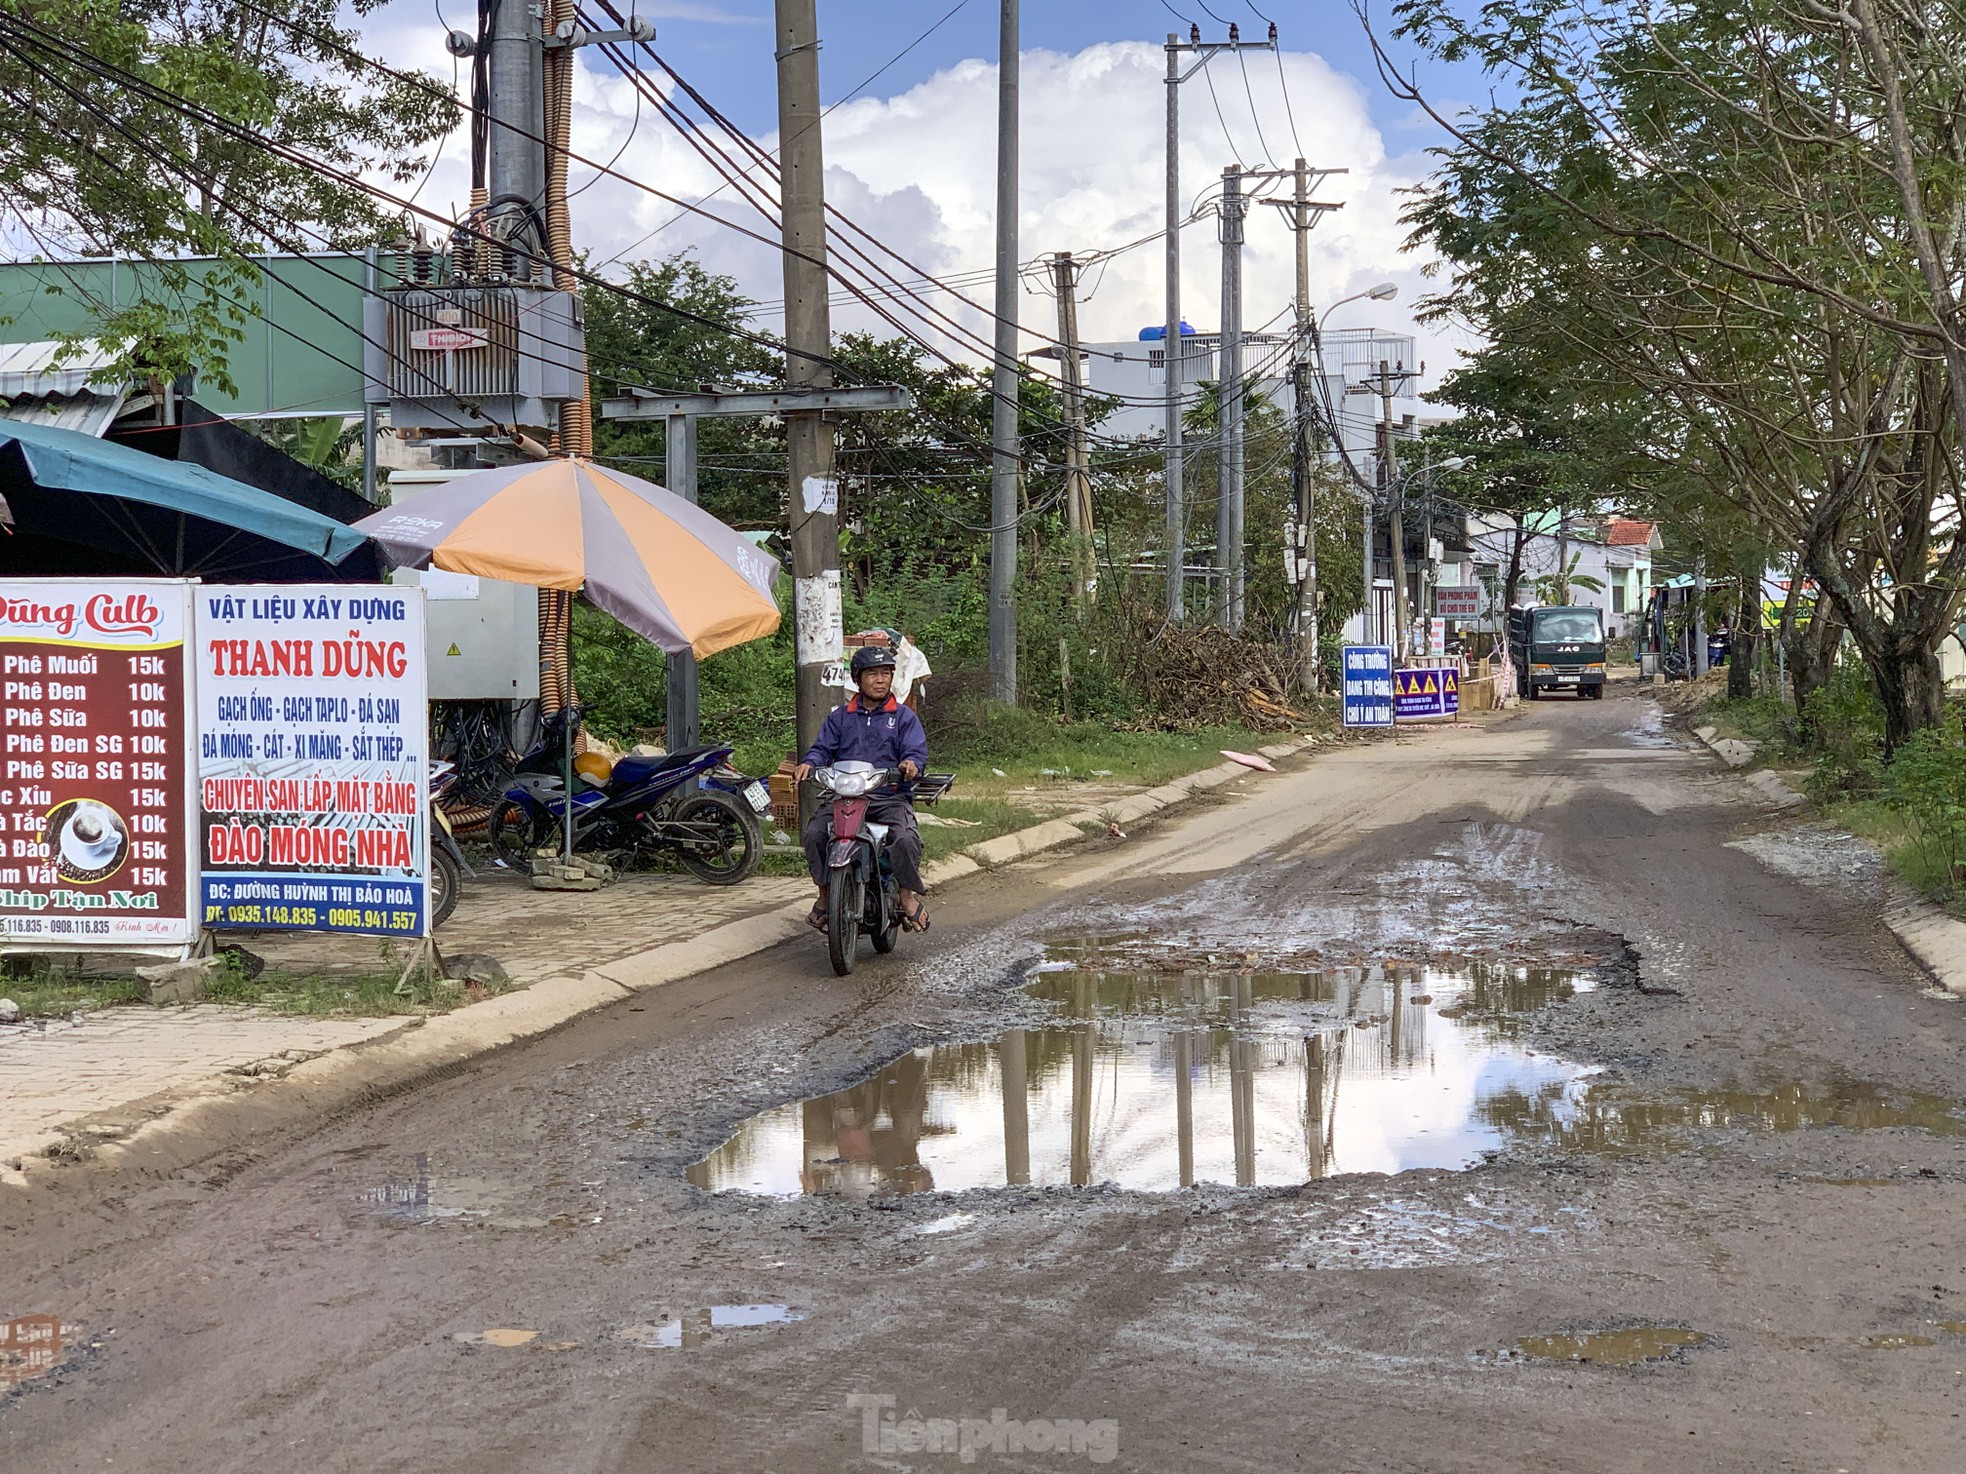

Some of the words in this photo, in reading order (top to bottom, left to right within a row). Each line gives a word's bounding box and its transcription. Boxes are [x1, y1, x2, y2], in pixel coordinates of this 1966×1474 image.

[85, 594, 158, 637] Culb
[209, 594, 246, 623] VẬT
[252, 594, 296, 624] LIỆU
[302, 594, 342, 619] XÂY
[349, 597, 405, 624] DỰNG
[1468, 604, 1475, 613] EM
[5, 655, 42, 674] Phê
[48, 653, 98, 674] Muối
[128, 656, 165, 675] 15k
[210, 639, 313, 677] THANH
[322, 629, 408, 678] DŨNG
[1348, 650, 1365, 670] CÔNG
[1365, 649, 1387, 669] TRƯỜNG
[5, 682, 43, 700] Phê
[48, 682, 87, 701] Đen
[128, 683, 166, 701] 10k
[1364, 680, 1373, 696] THI
[5, 708, 43, 726] Phê
[49, 708, 87, 727] Sữa
[129, 709, 166, 727] 10k
[218, 696, 247, 727] GẠCH
[250, 687, 272, 722] ỐNG
[283, 696, 312, 727] GẠCH
[315, 697, 348, 723] TAPLO
[359, 692, 374, 724] ĐÁ
[377, 698, 400, 729] SẠN
[1347, 704, 1360, 722] CHÚ
[1360, 703, 1365, 722] Ý
[1365, 706, 1374, 722] AN
[1374, 703, 1390, 722] TOÀN
[6, 734, 45, 753] Phê
[50, 735, 89, 753] Đen
[95, 735, 123, 753] SG
[129, 735, 166, 754] 10k
[202, 728, 217, 758] ĐÁ
[221, 728, 253, 759] MÓNG
[263, 728, 284, 759] CÁT
[295, 734, 306, 759] XI
[309, 730, 341, 760] MĂNG
[352, 726, 373, 761] SẮT
[376, 731, 403, 762] THÉP
[7, 761, 45, 779] Phê
[51, 761, 89, 779] Sữa
[95, 761, 123, 780] SG
[130, 762, 166, 780] 15k
[19, 785, 51, 805] Xỉu
[130, 788, 166, 806] 15k
[204, 772, 264, 811] CHUYÊN
[268, 779, 299, 811] SAN
[303, 769, 331, 812] LẤP
[336, 775, 369, 820] MẶT
[374, 770, 416, 815] BẰNG
[12, 809, 47, 831] Tắc
[130, 814, 166, 833] 10k
[13, 839, 50, 858] Đào
[130, 841, 166, 859] 15k
[210, 818, 262, 863] ĐÀO
[270, 818, 348, 865] MÓNG
[357, 822, 411, 867] NHÀ
[27, 861, 58, 884] Vắt
[131, 867, 166, 885] 15k
[52, 889, 107, 910] Tận
[109, 890, 159, 909] Nơi
[209, 884, 231, 899] ĐC:
[234, 882, 280, 900] ĐƯỜNG
[284, 883, 328, 902] HUỲNH
[331, 886, 352, 906] THỊ
[355, 882, 382, 904] BẢO
[386, 886, 413, 906] HOÀ
[50, 920, 109, 934] 0908.116.835
[206, 905, 225, 923] ĐT:
[228, 905, 316, 925] 0935.148.835
[329, 908, 417, 930] 0905.941.557
